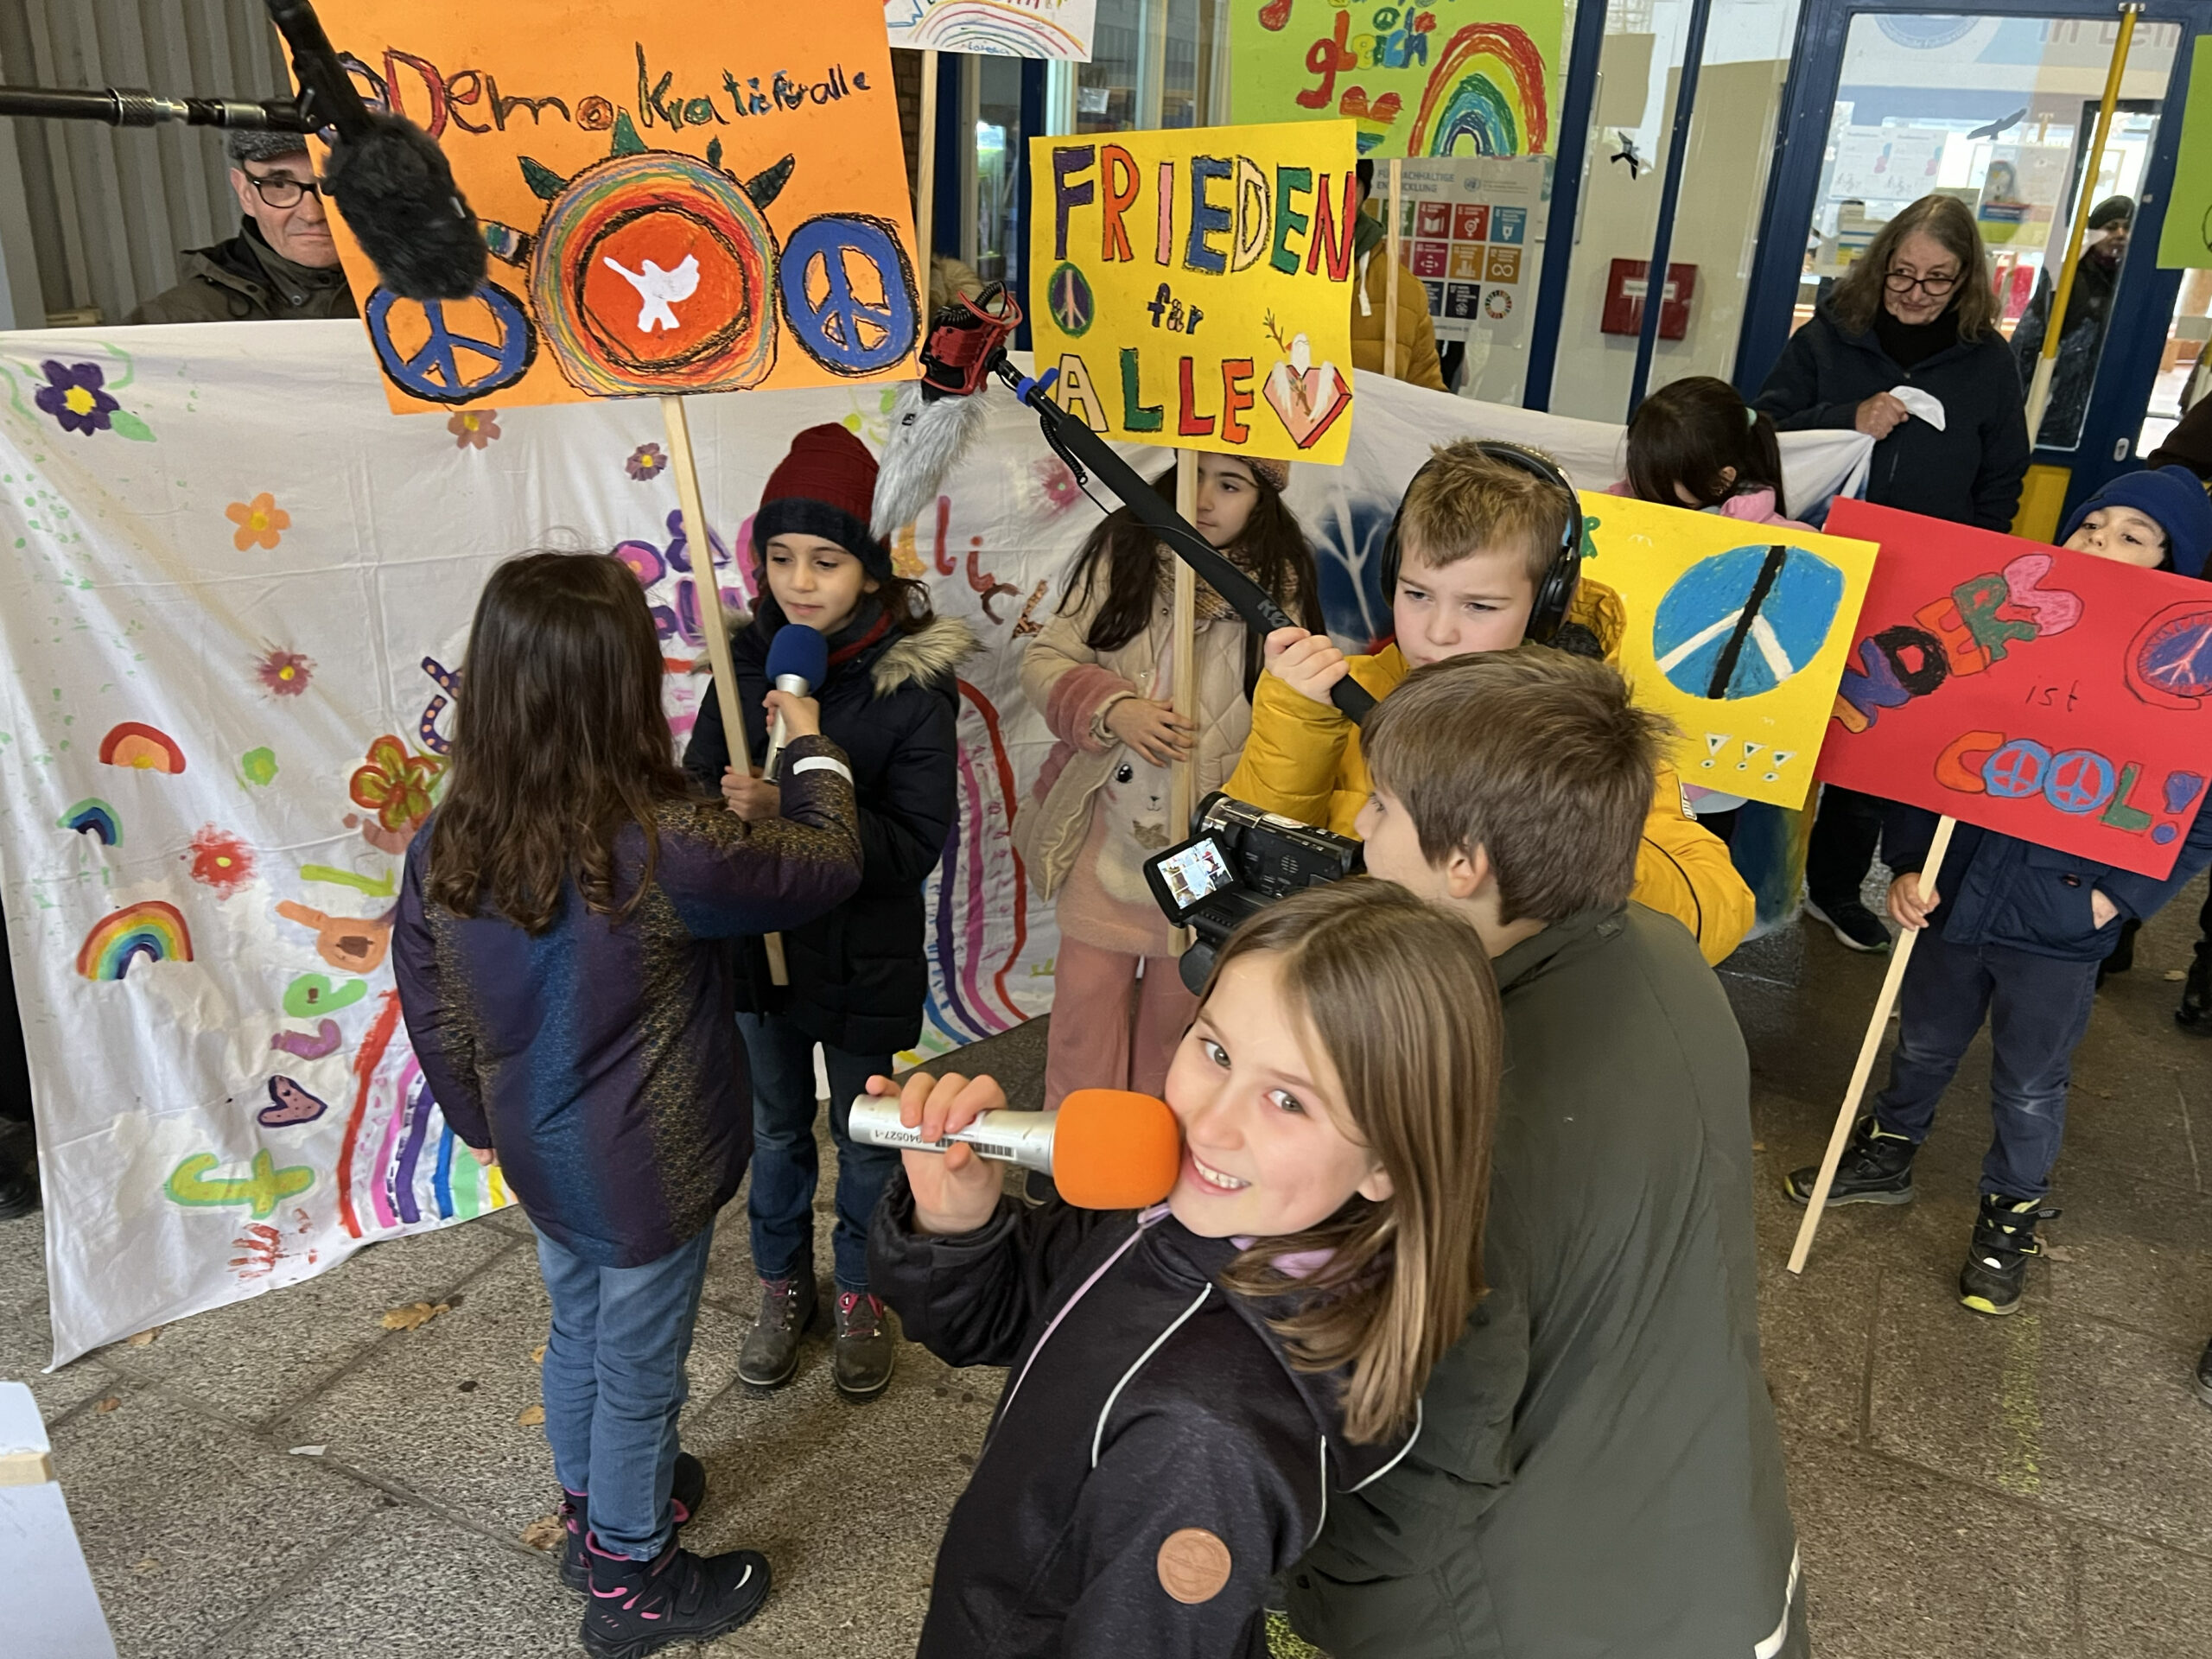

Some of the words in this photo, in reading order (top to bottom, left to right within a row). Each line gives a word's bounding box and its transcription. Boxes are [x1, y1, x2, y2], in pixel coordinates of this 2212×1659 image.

[1052, 143, 1355, 282] FRIEDEN
[1147, 283, 1204, 334] für
[1056, 347, 1255, 444] ALLE
